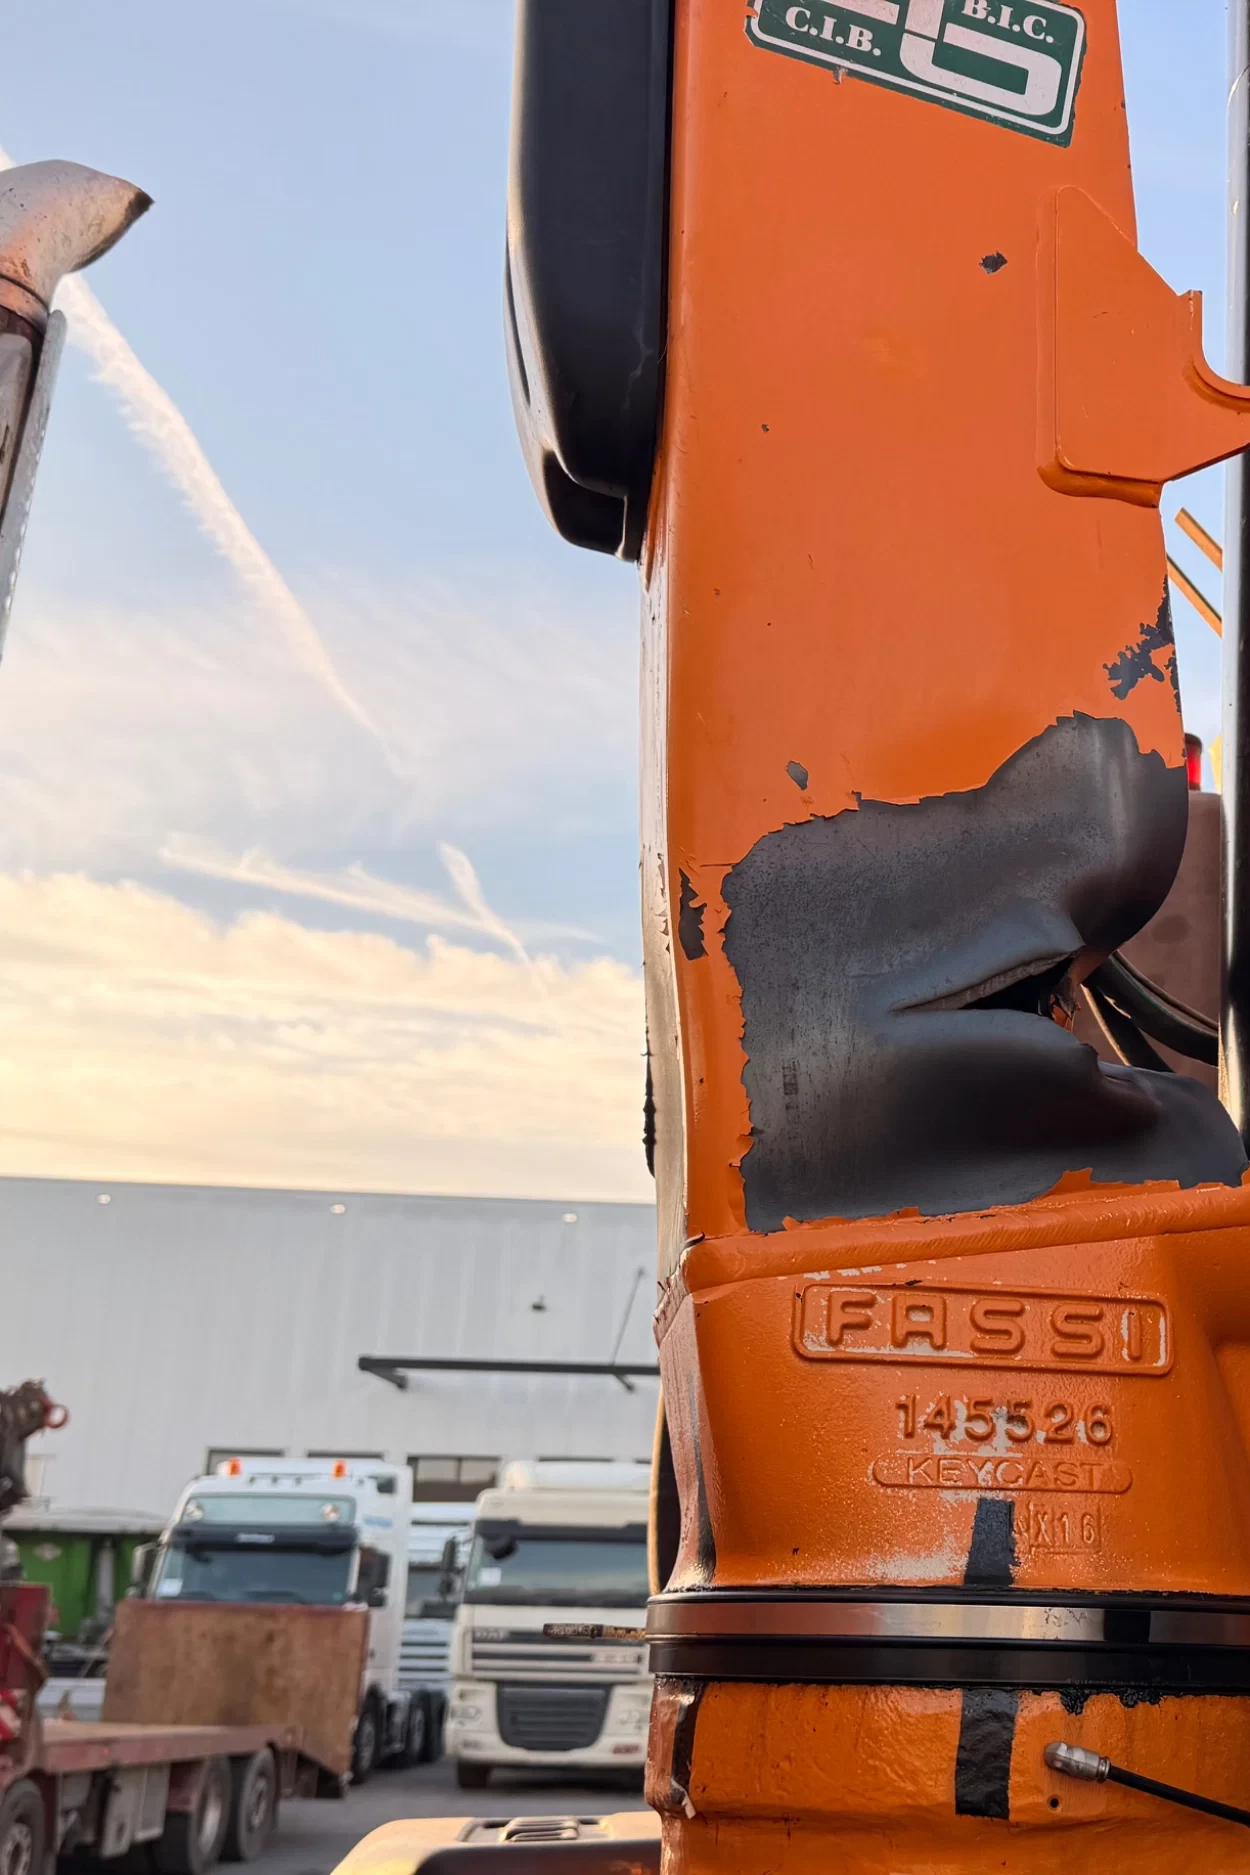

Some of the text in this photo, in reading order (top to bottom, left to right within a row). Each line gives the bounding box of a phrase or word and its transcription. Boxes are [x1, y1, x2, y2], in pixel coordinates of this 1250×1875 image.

[785, 6, 882, 57] C.I.B.
[961, 0, 1054, 44] B.I.C.
[827, 1290, 1144, 1362] FASSI
[896, 1393, 1114, 1447] 145526
[906, 1456, 1105, 1487] KEYCAST
